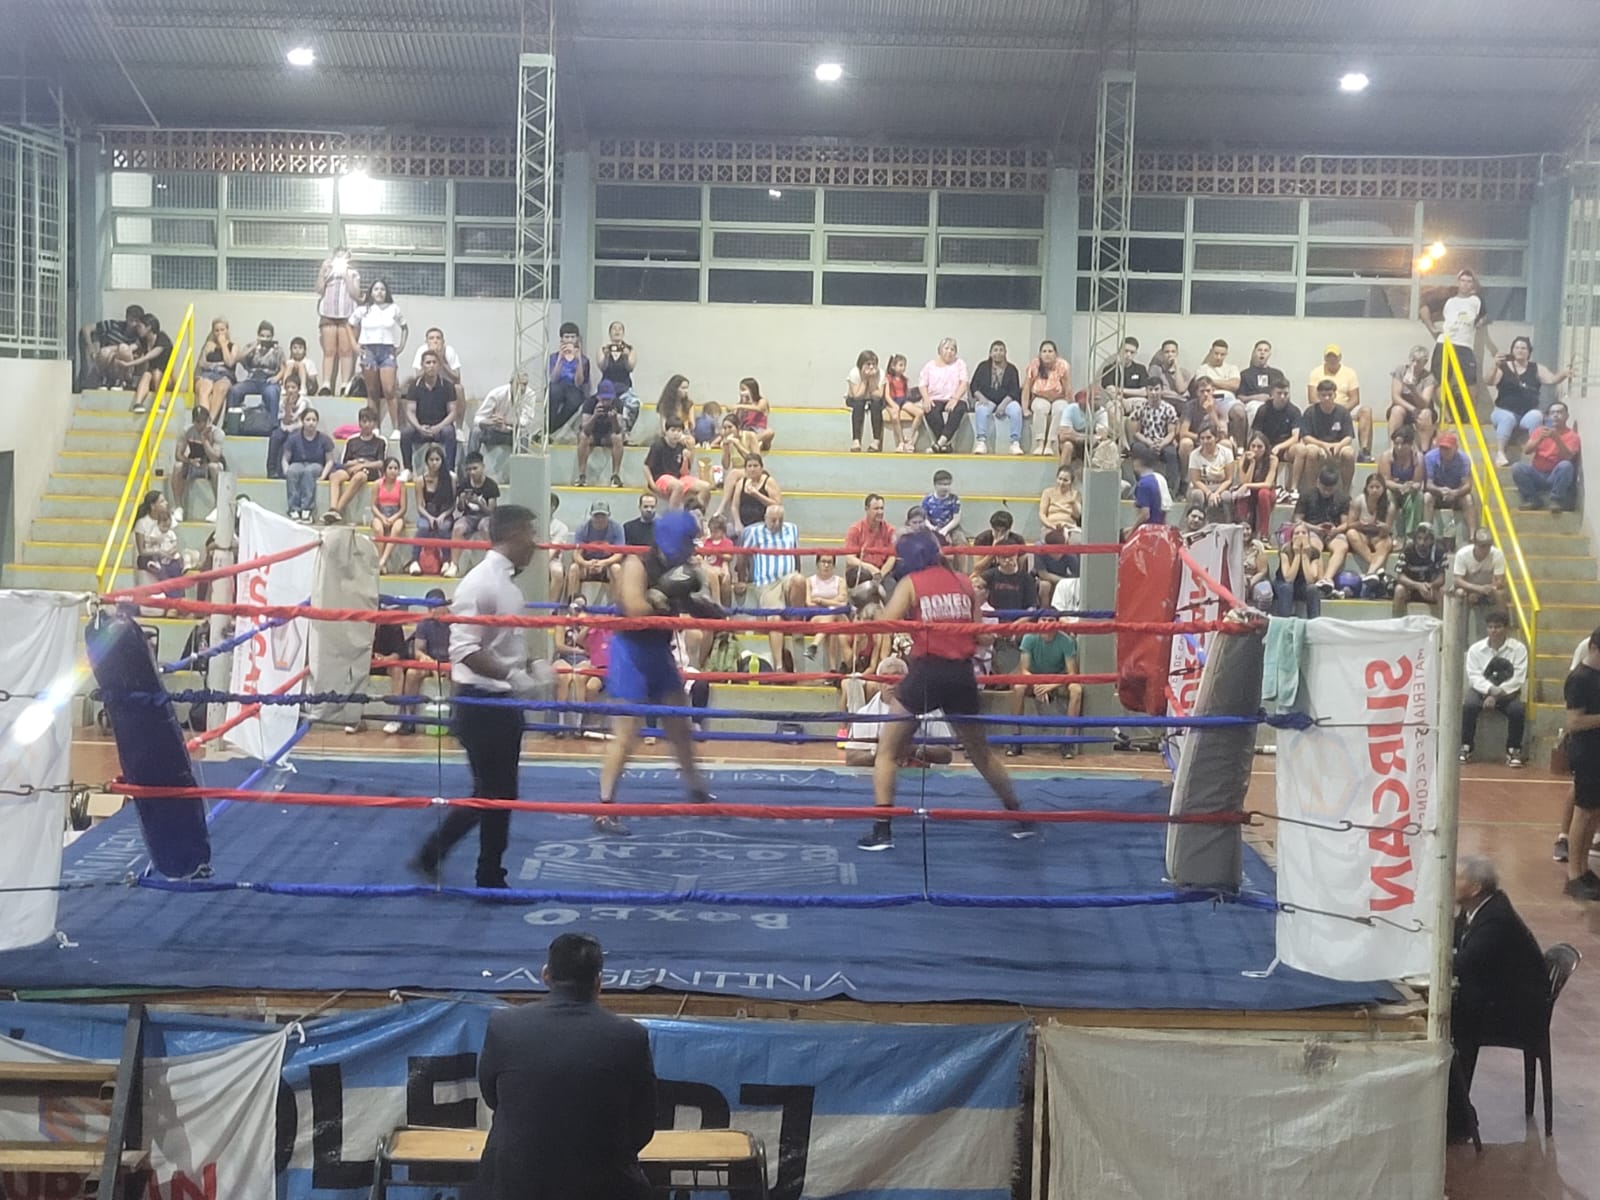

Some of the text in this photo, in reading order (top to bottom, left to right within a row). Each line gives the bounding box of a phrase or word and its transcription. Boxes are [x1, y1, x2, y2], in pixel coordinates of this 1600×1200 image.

[533, 843, 839, 862] BOXING
[523, 906, 791, 930] BOXEO
[494, 966, 857, 992] AGENTINA
